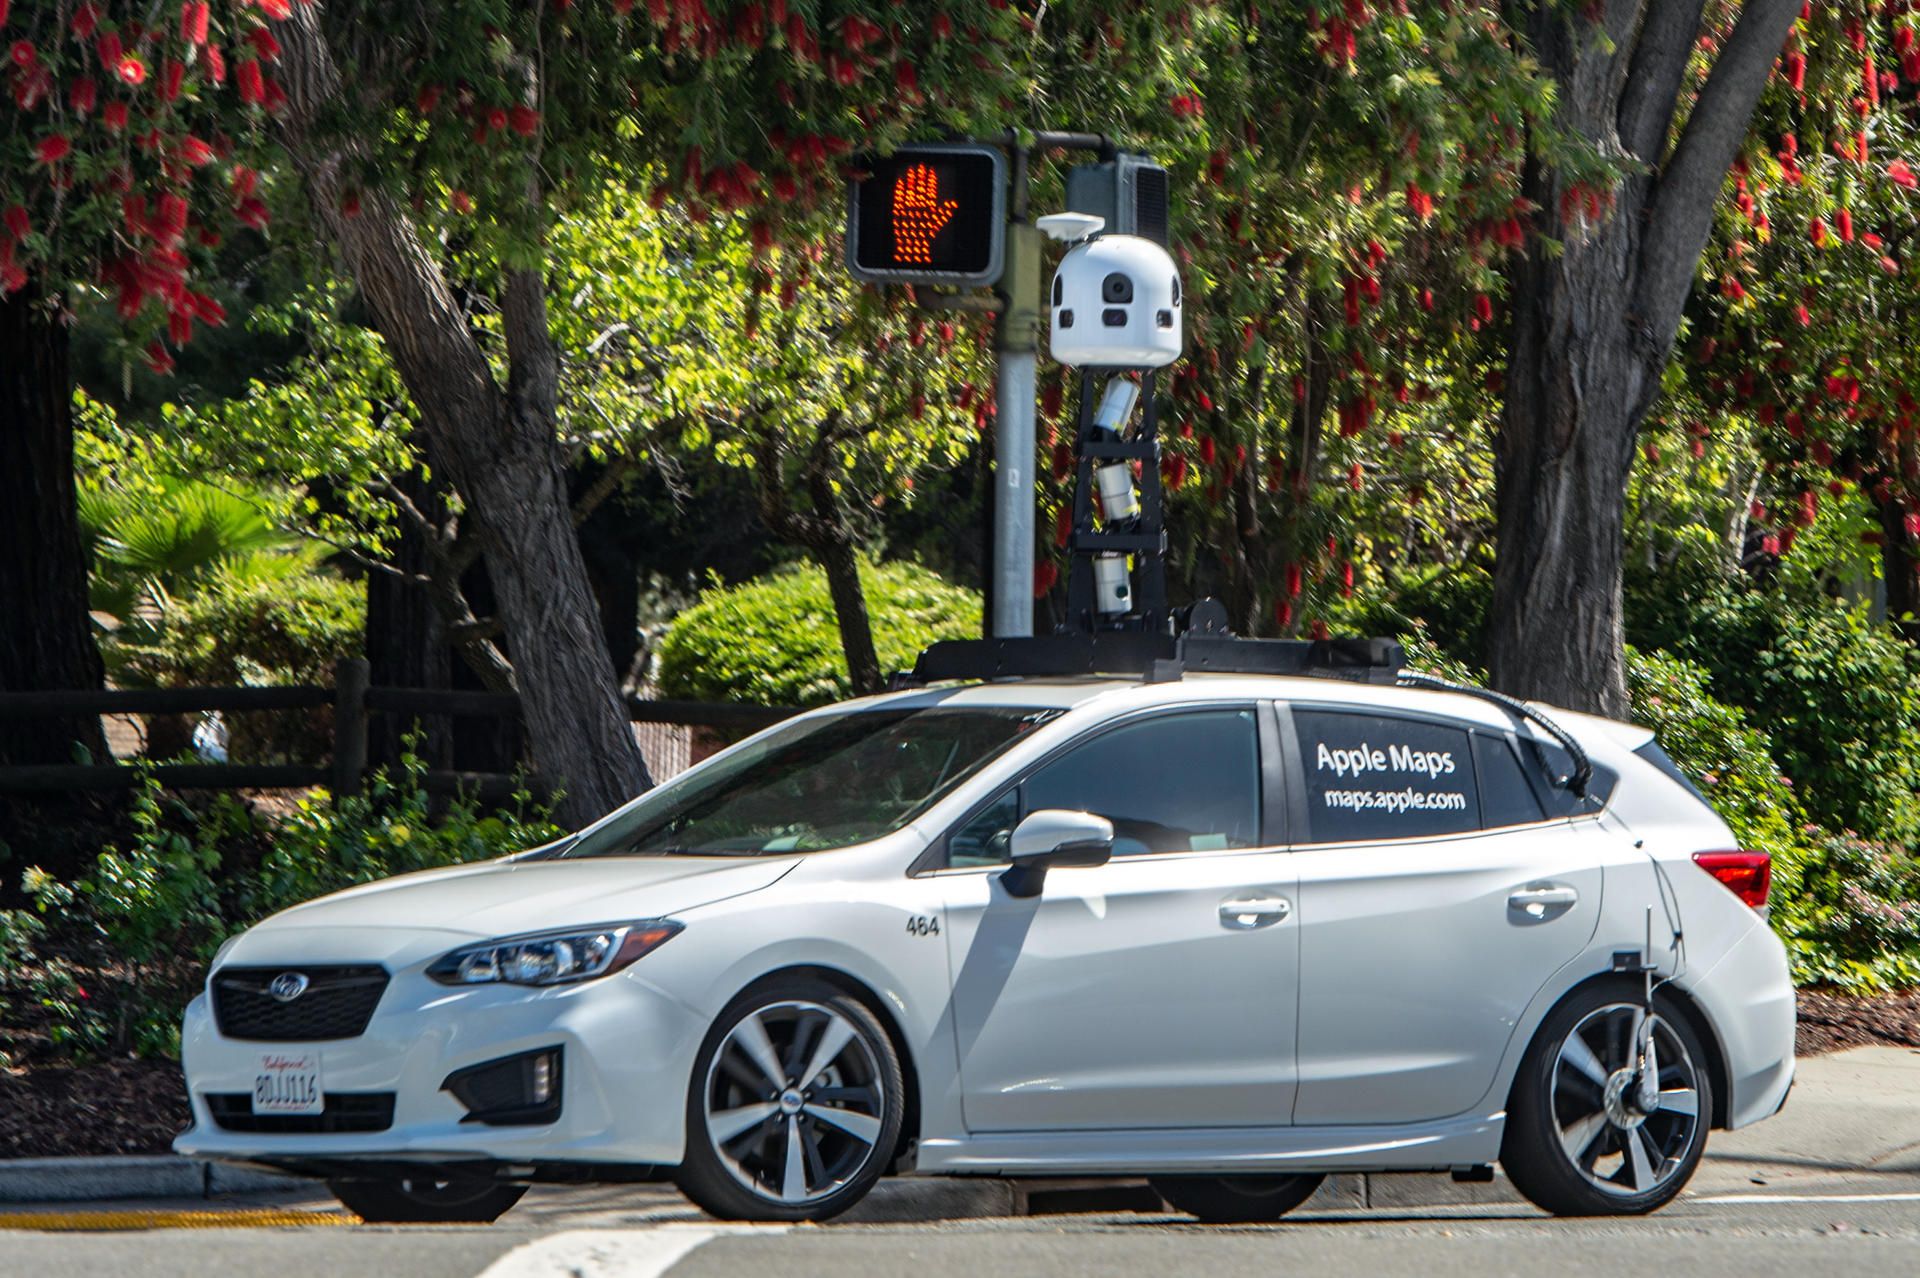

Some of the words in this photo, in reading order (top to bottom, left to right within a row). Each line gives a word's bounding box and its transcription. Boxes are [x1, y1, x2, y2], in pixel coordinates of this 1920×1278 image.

[1317, 743, 1387, 777] Apple
[1388, 744, 1455, 779] Maps
[1324, 787, 1466, 813] maps.apple.com
[906, 915, 940, 937] 464
